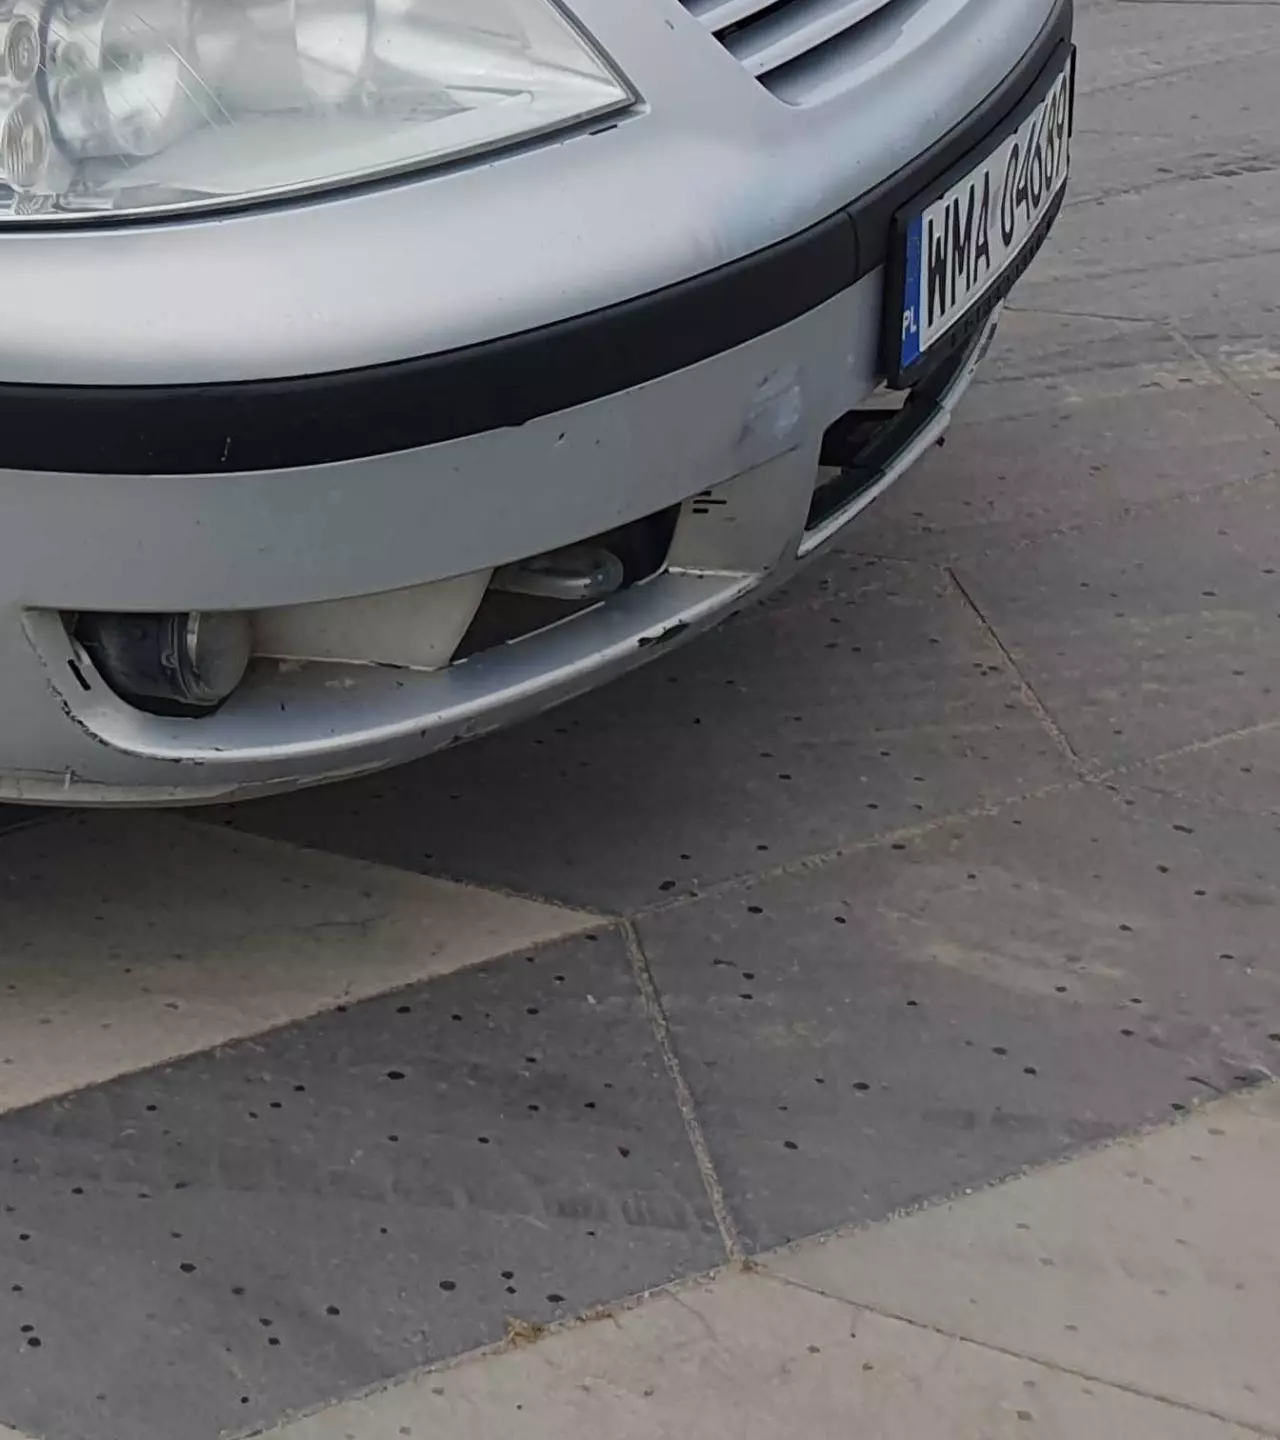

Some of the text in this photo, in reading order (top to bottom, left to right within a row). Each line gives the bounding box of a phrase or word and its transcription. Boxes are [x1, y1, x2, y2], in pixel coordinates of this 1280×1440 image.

[928, 171, 989, 327] WMA
[1001, 73, 1066, 246] 04689
[901, 308, 917, 342] PL
